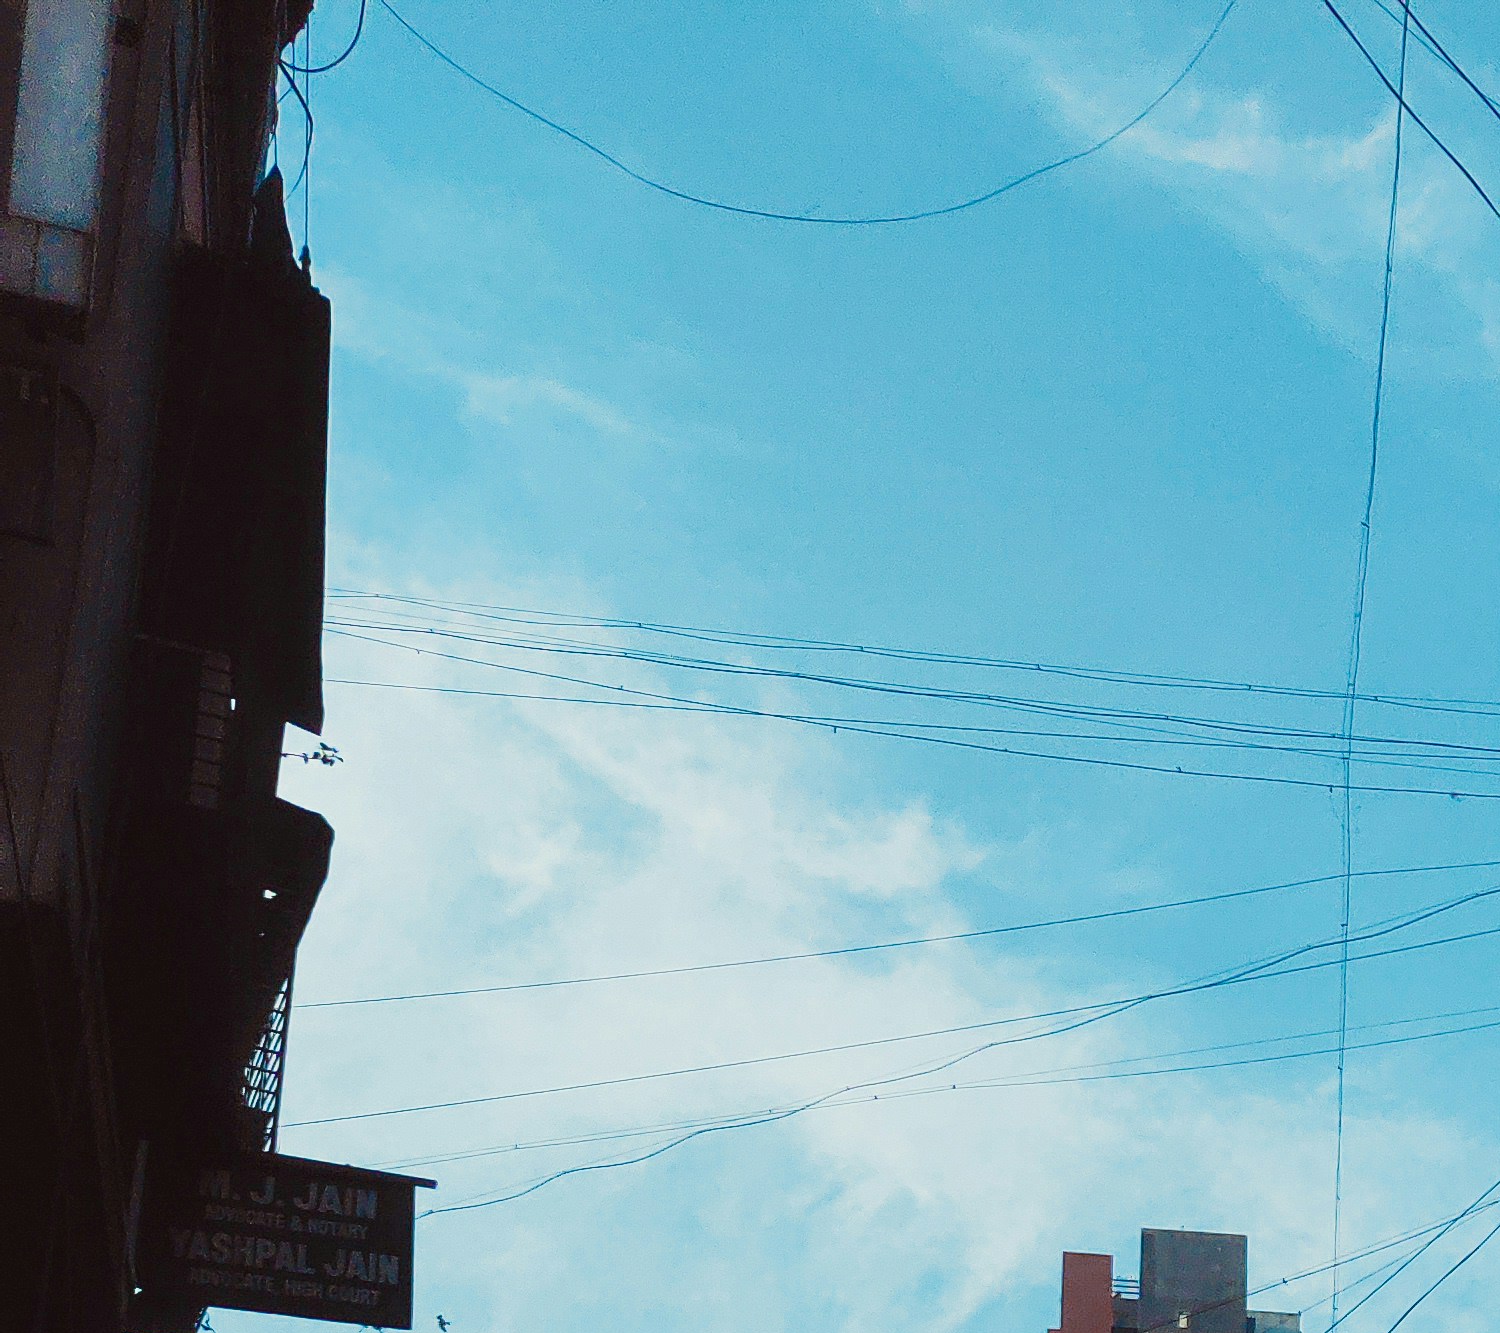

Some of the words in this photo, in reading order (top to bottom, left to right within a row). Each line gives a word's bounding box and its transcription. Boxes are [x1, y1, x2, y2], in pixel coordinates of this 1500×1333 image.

[293, 1182, 378, 1220] JAIN
[170, 1227, 315, 1275] YASHPAL
[323, 1248, 399, 1285] JAIN
